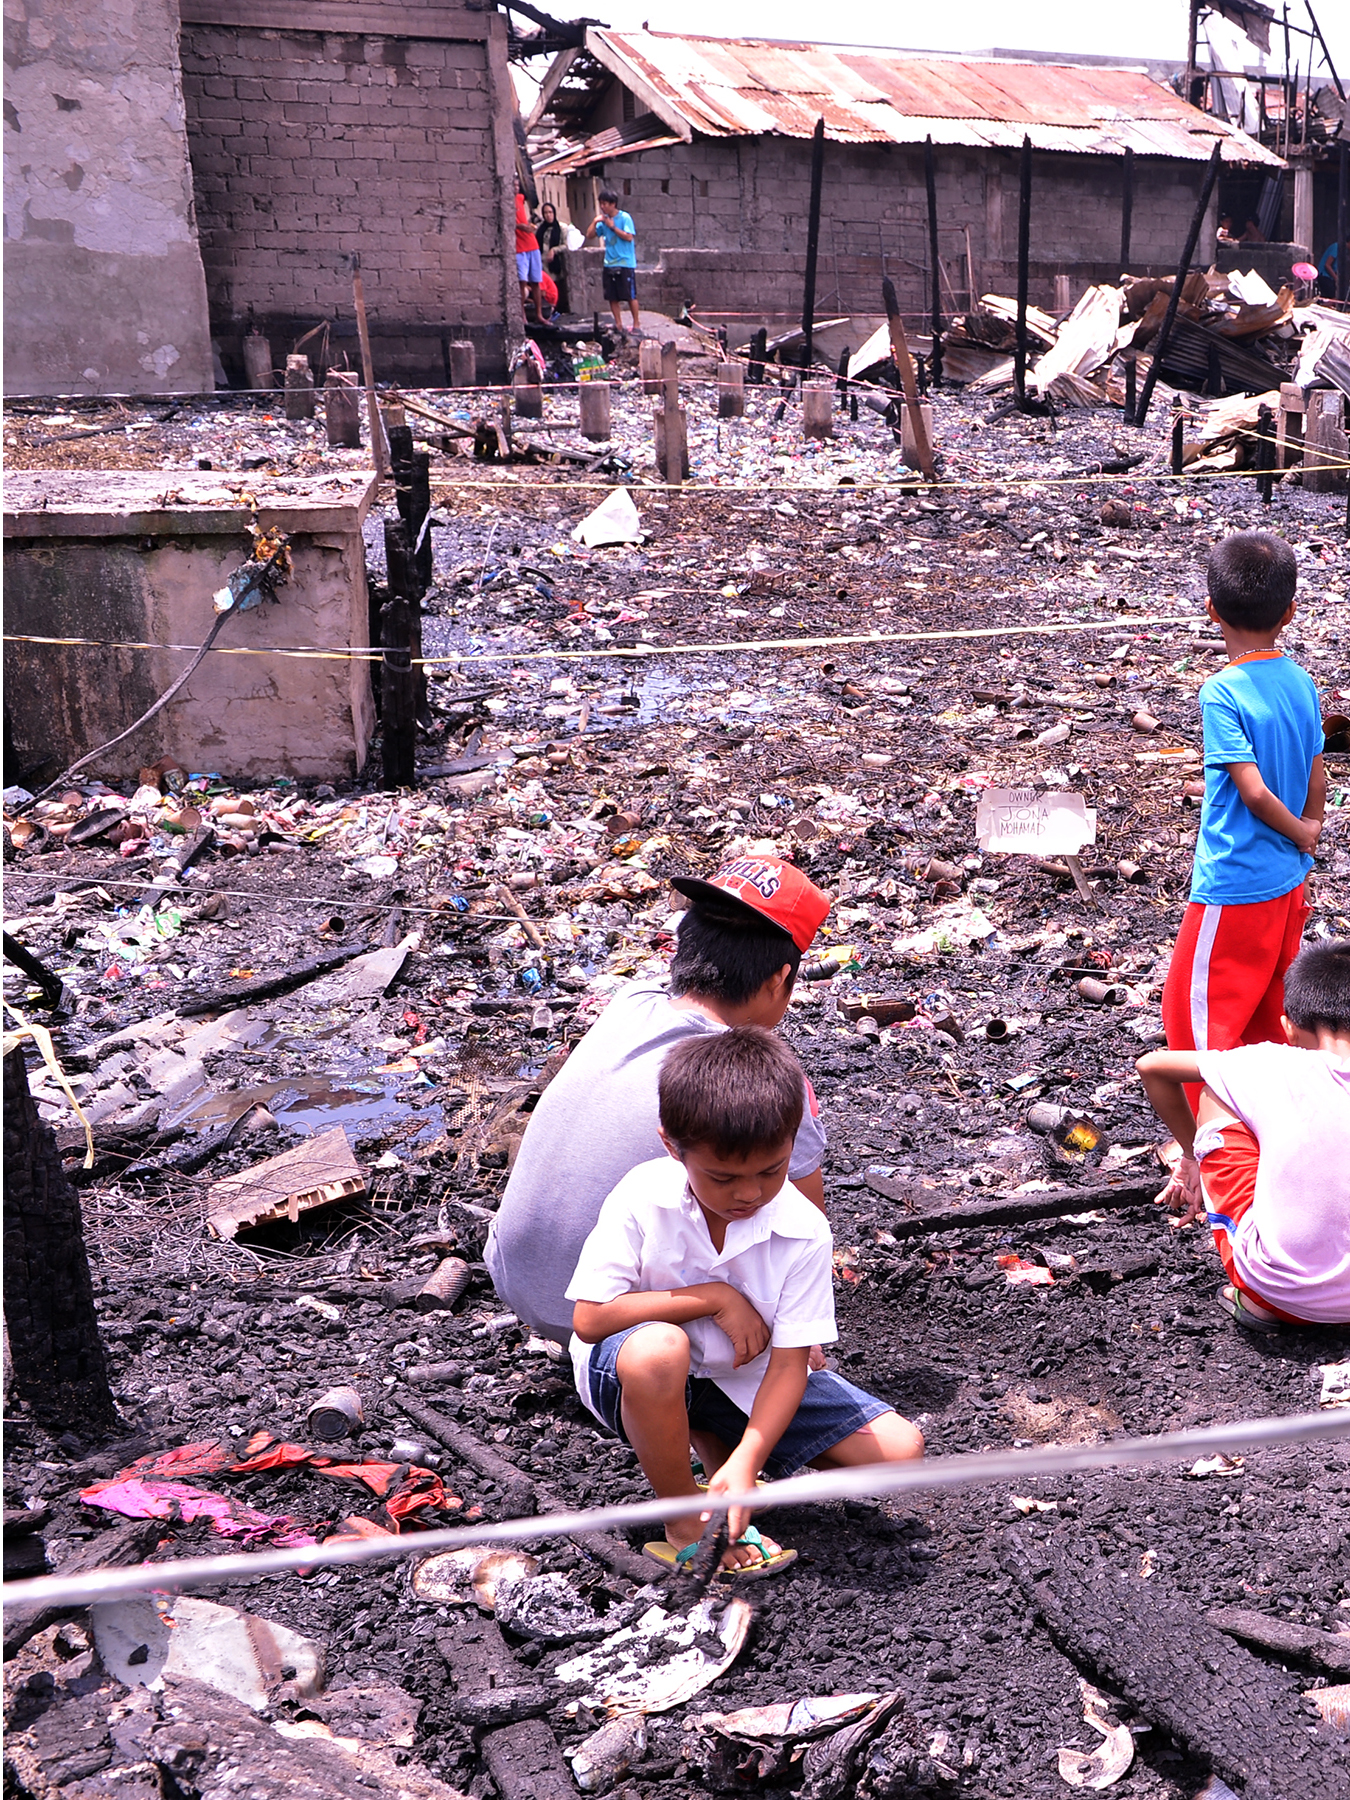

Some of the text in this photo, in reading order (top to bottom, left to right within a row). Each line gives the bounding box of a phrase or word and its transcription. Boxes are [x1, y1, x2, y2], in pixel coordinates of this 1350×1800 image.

[998, 805, 1049, 822] JONA
[1000, 821, 1046, 836] MOHAMAD
[709, 859, 781, 899] BULLS
